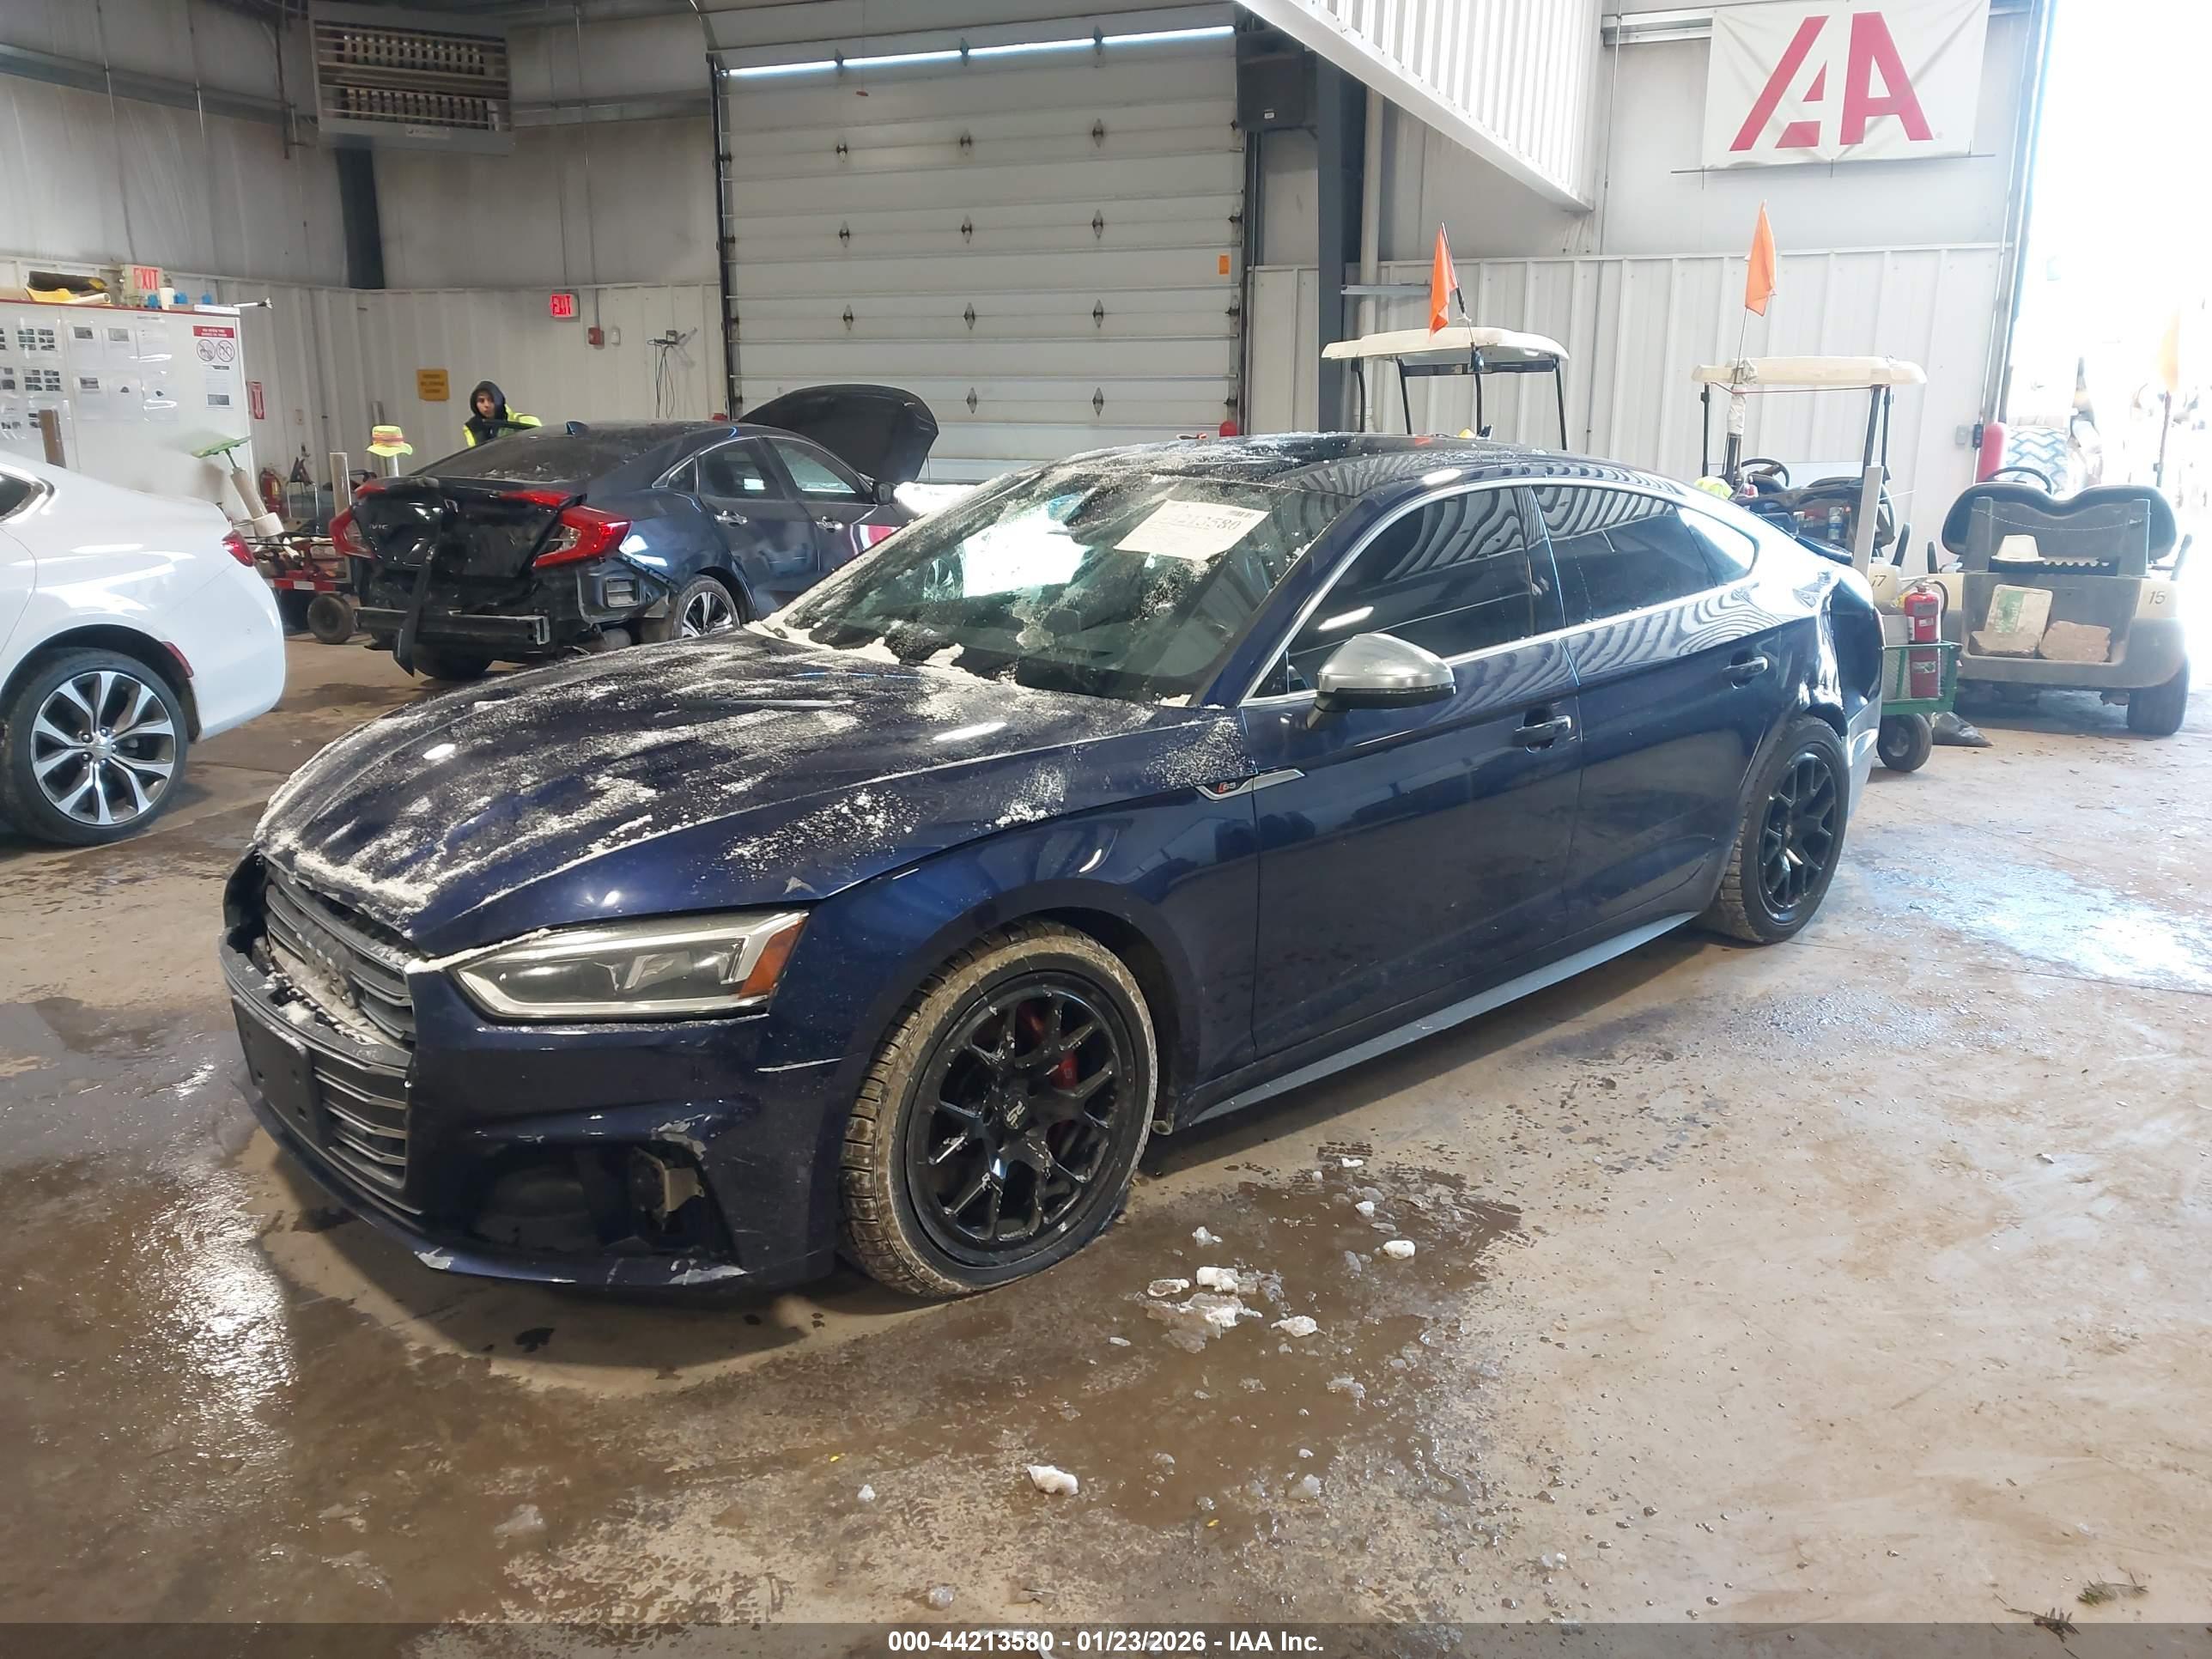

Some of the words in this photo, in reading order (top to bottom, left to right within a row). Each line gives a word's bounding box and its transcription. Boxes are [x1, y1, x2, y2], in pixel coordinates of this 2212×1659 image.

[133, 267, 159, 289] EXIT
[551, 295, 571, 316] EXIT
[2148, 590, 2166, 605] 15
